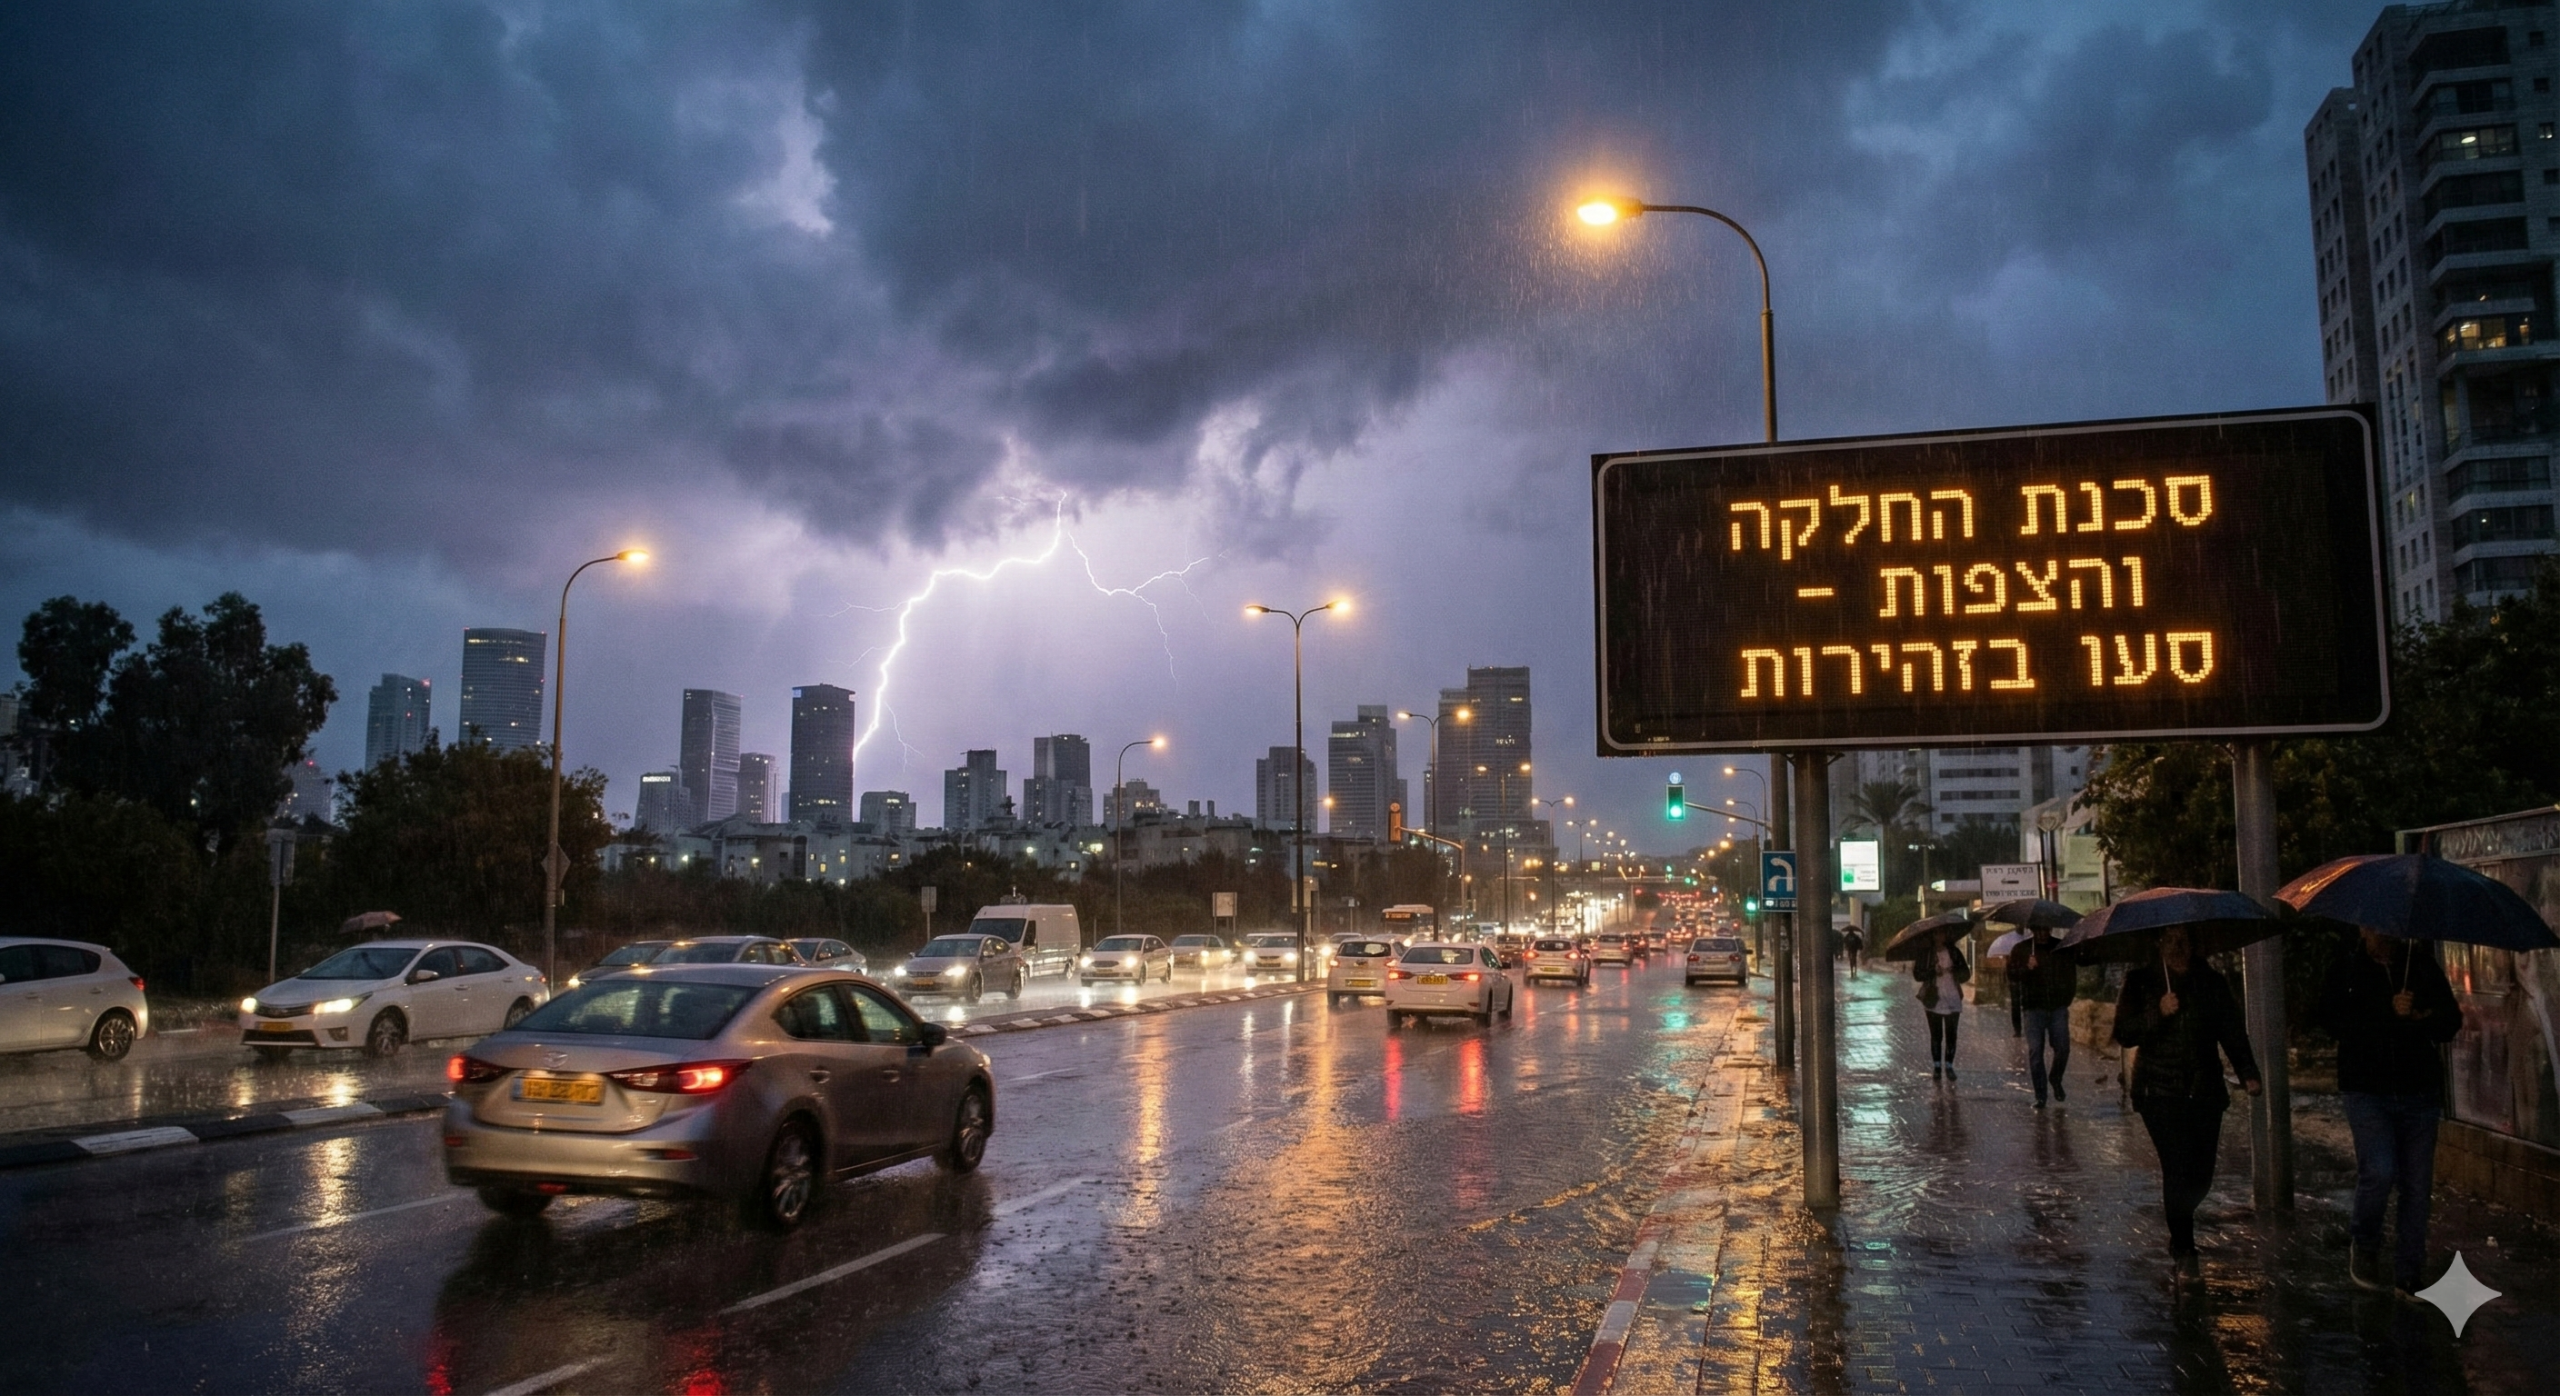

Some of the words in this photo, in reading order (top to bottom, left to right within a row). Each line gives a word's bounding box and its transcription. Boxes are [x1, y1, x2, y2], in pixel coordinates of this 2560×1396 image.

[1730, 484, 1974, 561] החלקה
[2020, 474, 2213, 536] סכנת
[1879, 556, 2144, 618] והצפות
[1740, 638, 2036, 698] בזהירות
[2080, 631, 2214, 691] סעו
